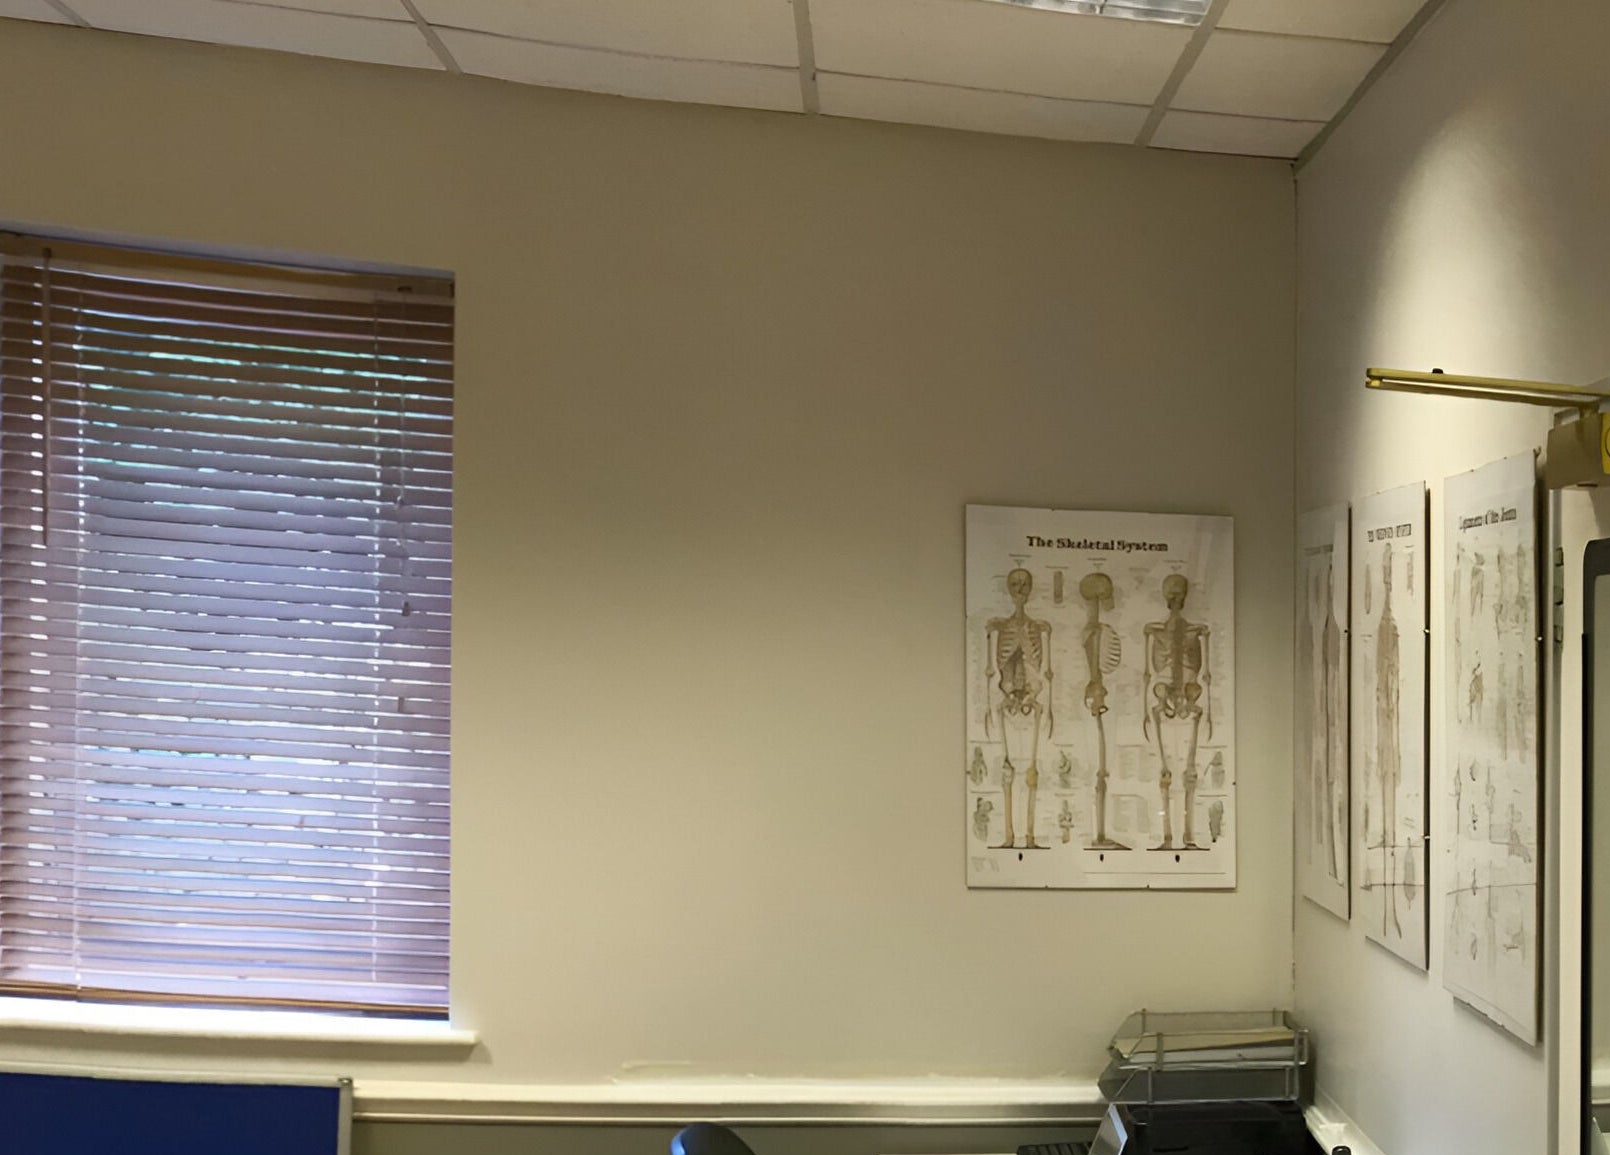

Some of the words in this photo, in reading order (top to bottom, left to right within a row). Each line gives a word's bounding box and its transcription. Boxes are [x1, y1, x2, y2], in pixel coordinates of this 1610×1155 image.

[1026, 535, 1053, 548] The
[1056, 538, 1115, 551] Skeletal
[1117, 540, 1169, 553] System
